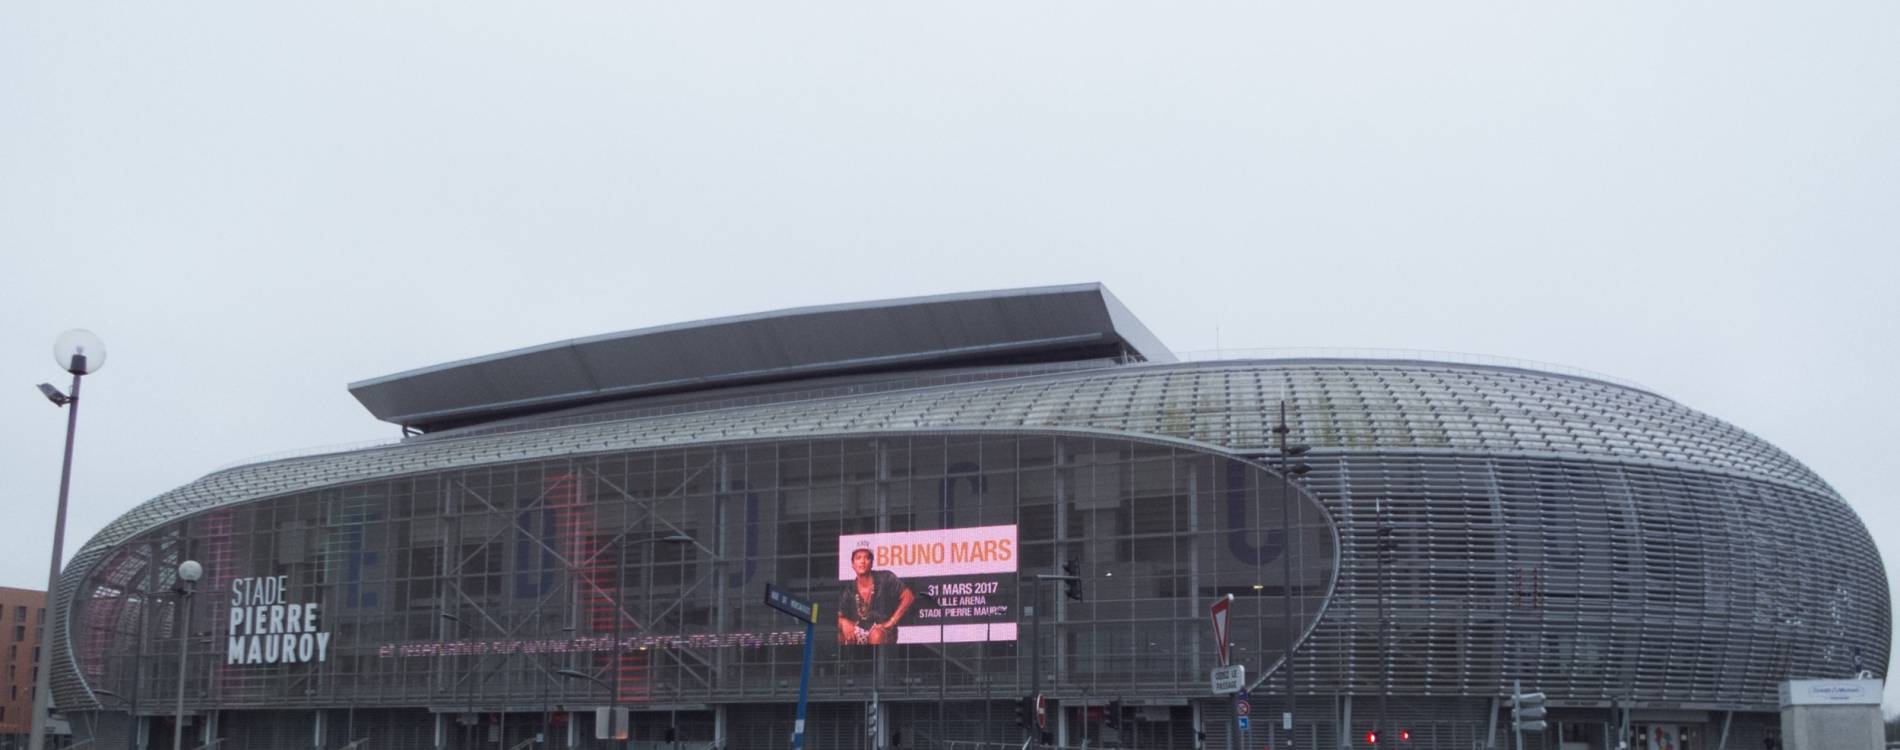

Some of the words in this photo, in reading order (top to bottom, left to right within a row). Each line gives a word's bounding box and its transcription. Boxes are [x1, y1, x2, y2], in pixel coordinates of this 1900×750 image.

[876, 543, 945, 567] BRUNO
[951, 538, 1012, 564] MARS
[231, 575, 289, 606] STADE
[928, 584, 939, 596] 31
[943, 582, 972, 595] MARS
[974, 580, 998, 594] 2017
[960, 595, 986, 606] ARENA
[230, 603, 318, 635] PIERRE
[945, 607, 972, 617] PIERRE
[228, 631, 331, 665] MAUROY
